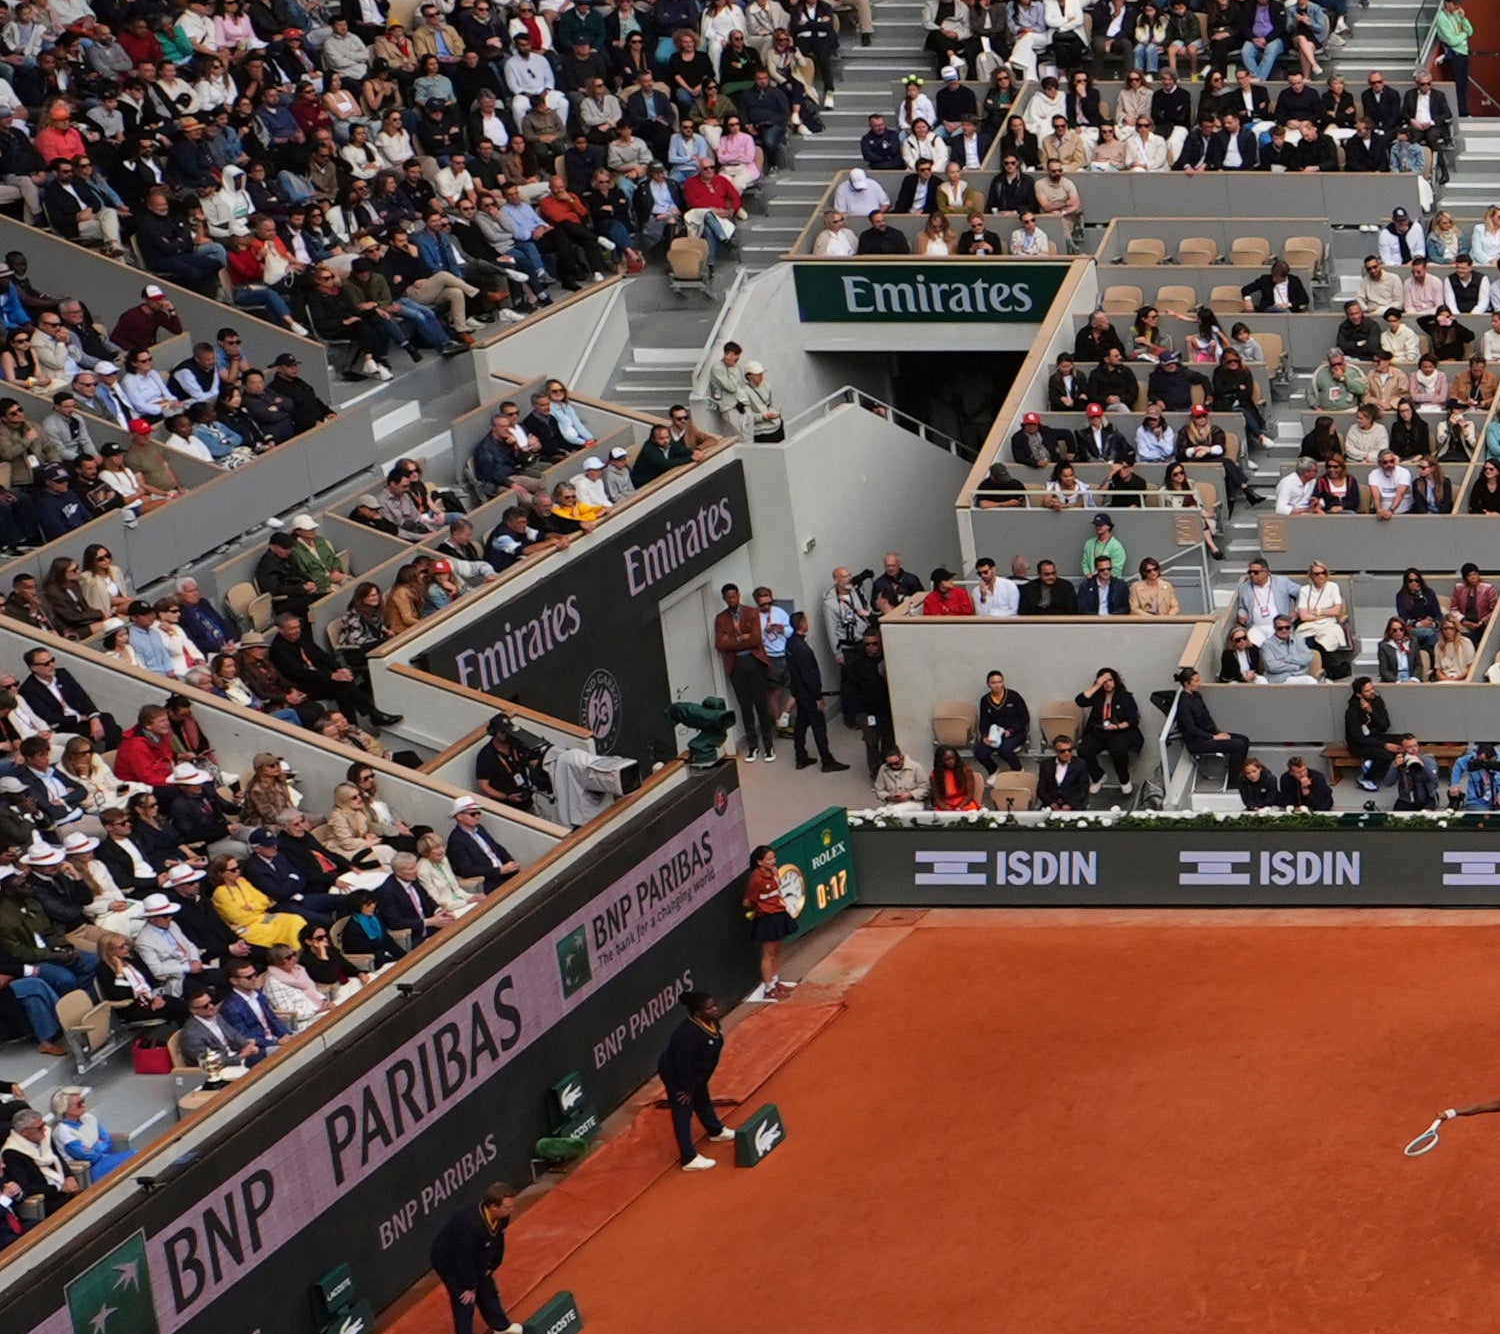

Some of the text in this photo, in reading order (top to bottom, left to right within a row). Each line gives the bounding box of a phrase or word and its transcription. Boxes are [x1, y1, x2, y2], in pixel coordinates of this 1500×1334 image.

[841, 274, 1033, 313] Emirates
[623, 497, 732, 597] Emirates
[455, 595, 581, 693] Emirates
[812, 841, 846, 870] ROLEX
[996, 851, 1097, 886] ISDIN
[1260, 851, 1361, 886] ISDIN
[592, 830, 713, 951] BNP PARIBAS
[817, 869, 847, 909] 0:17
[615, 931, 636, 955] bank
[593, 969, 694, 1069] BNP PARIBAS
[163, 974, 522, 1316] BNP PARIBAS
[570, 1115, 597, 1139] ACOSTE
[379, 1133, 498, 1250] BNP PARIBAS
